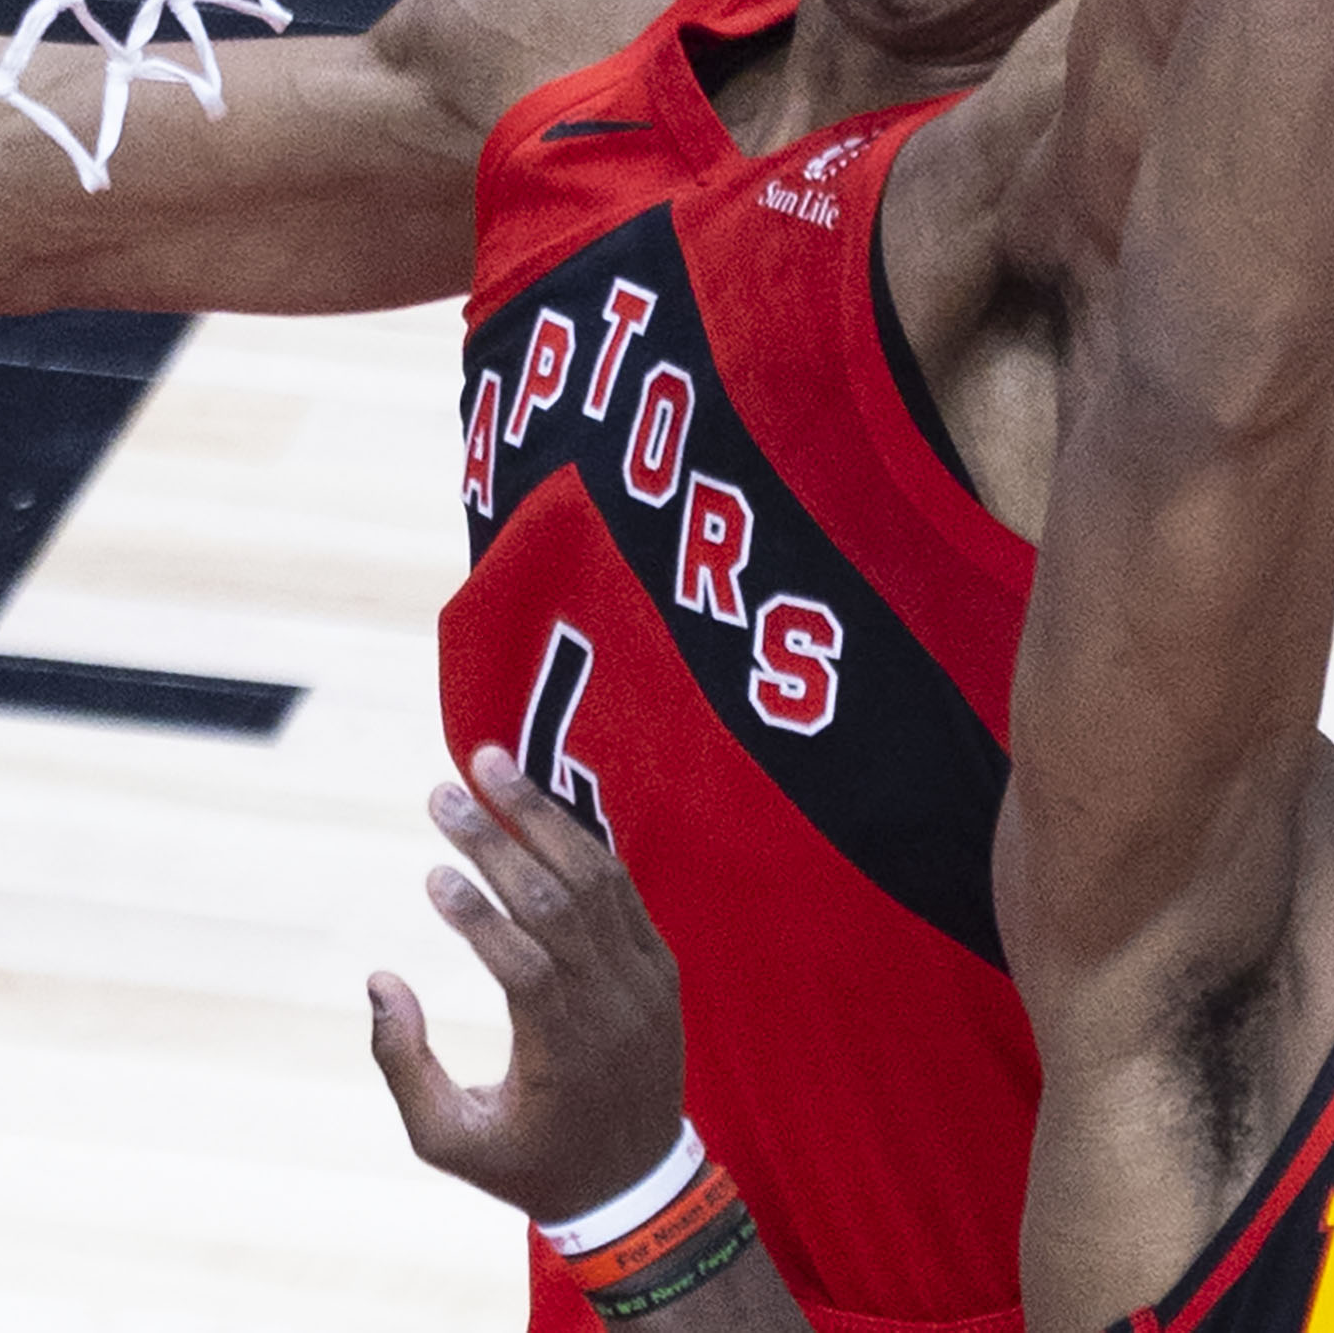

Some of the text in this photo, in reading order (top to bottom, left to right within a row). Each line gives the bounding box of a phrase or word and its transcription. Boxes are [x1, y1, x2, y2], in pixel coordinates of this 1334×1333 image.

[758, 179, 840, 230] Sun Life
[460, 277, 844, 736] APTORS
